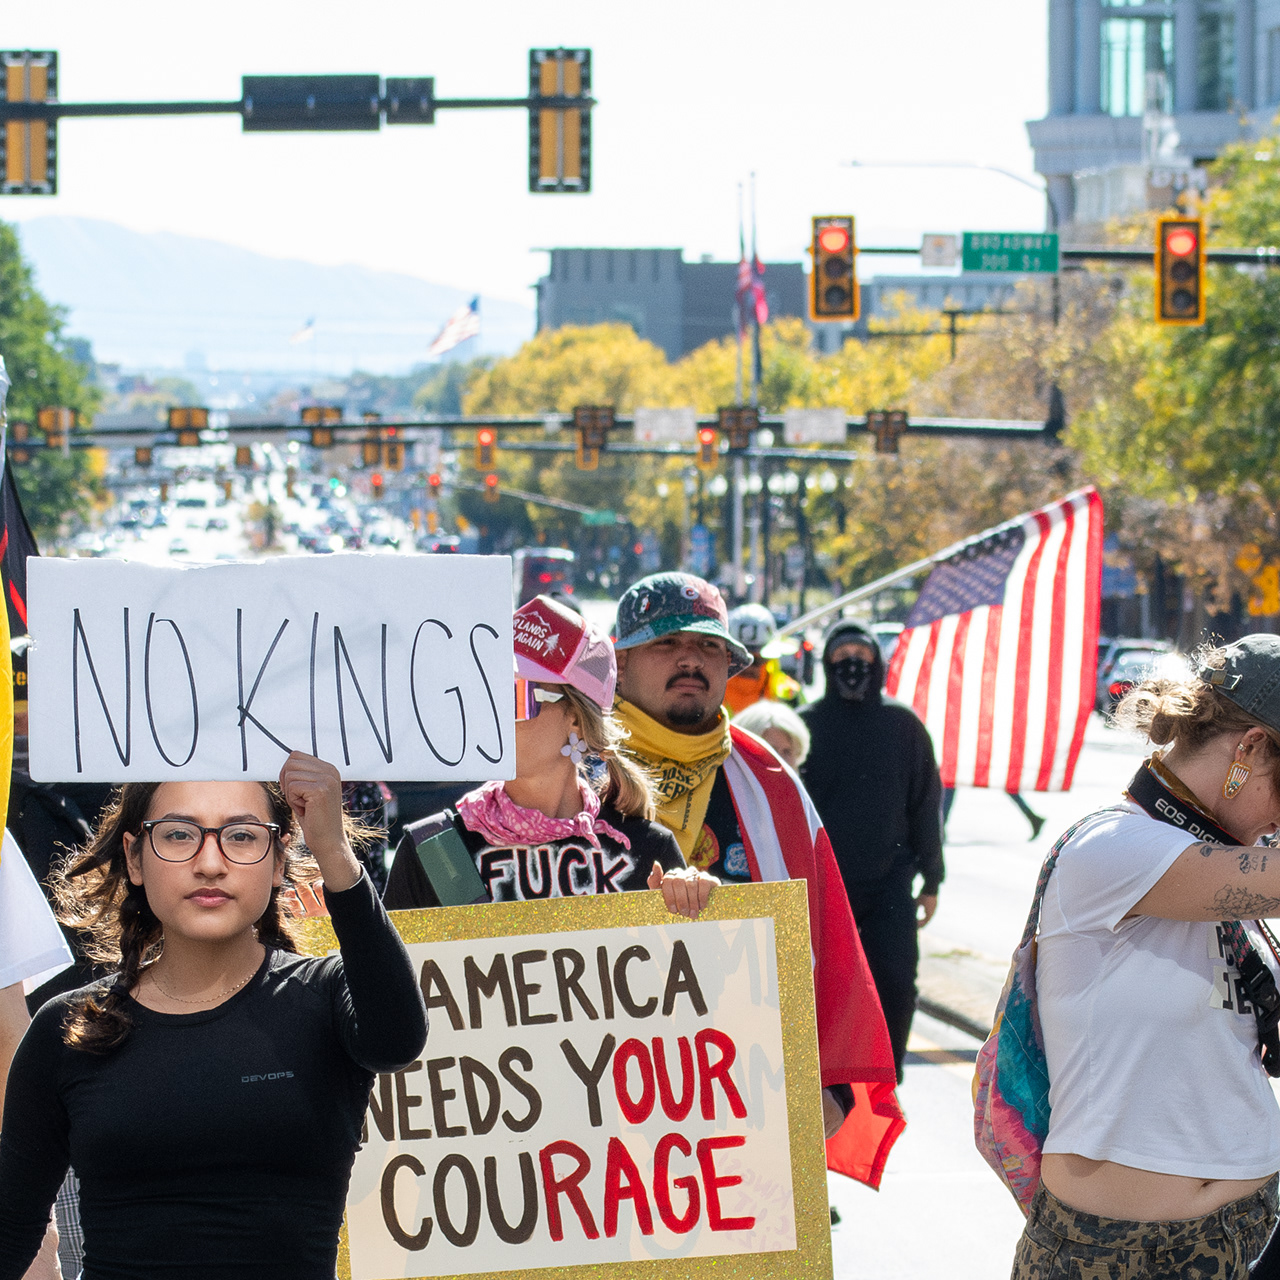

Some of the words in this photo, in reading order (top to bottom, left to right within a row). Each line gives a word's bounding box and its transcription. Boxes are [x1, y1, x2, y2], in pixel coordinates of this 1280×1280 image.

[971, 235, 1051, 249] BROADWAY
[71, 608, 200, 773] NO
[236, 608, 505, 772] KINGS
[1155, 798, 1187, 826] EOS
[1188, 823, 1225, 847] DIG
[479, 846, 629, 901] FUCK
[421, 940, 709, 1031] AMERICA
[362, 1046, 543, 1143] NEEDS
[560, 1028, 748, 1127] YOUR
[380, 1133, 757, 1251] COURAGE
